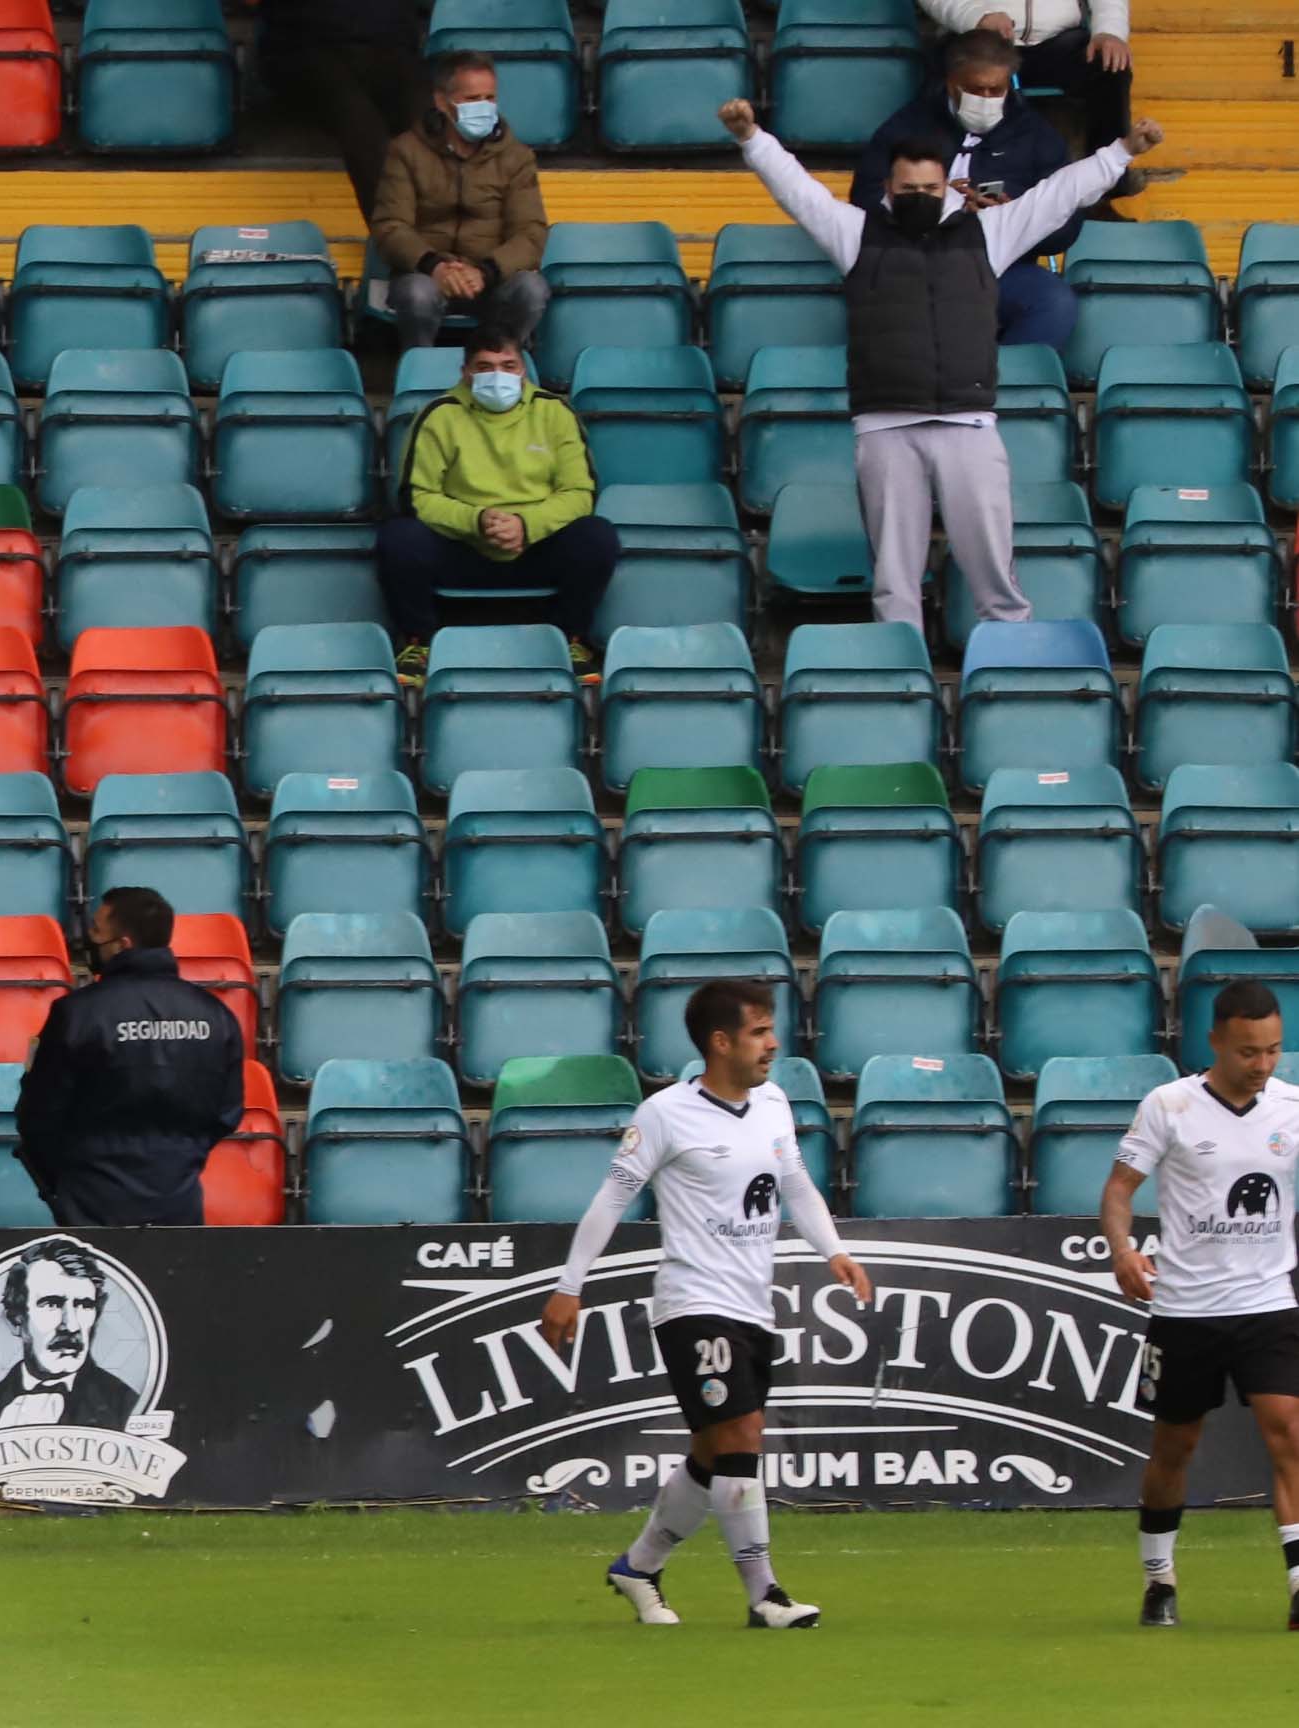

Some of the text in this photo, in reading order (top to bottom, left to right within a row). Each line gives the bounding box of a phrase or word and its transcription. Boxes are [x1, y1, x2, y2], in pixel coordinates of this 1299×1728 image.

[117, 1020, 210, 1042] SEGURIDAD
[1188, 1213, 1282, 1236] Salamanca
[416, 1236, 515, 1268] CAFÉ
[1060, 1233, 1162, 1262] COA
[403, 1281, 1156, 1437] LIVIGSTON
[694, 1336, 733, 1376] 20
[129, 1422, 165, 1431] COPAS
[624, 1449, 979, 1488] PRIUM BAR
[6, 1487, 104, 1497] PREMIUM BAR
